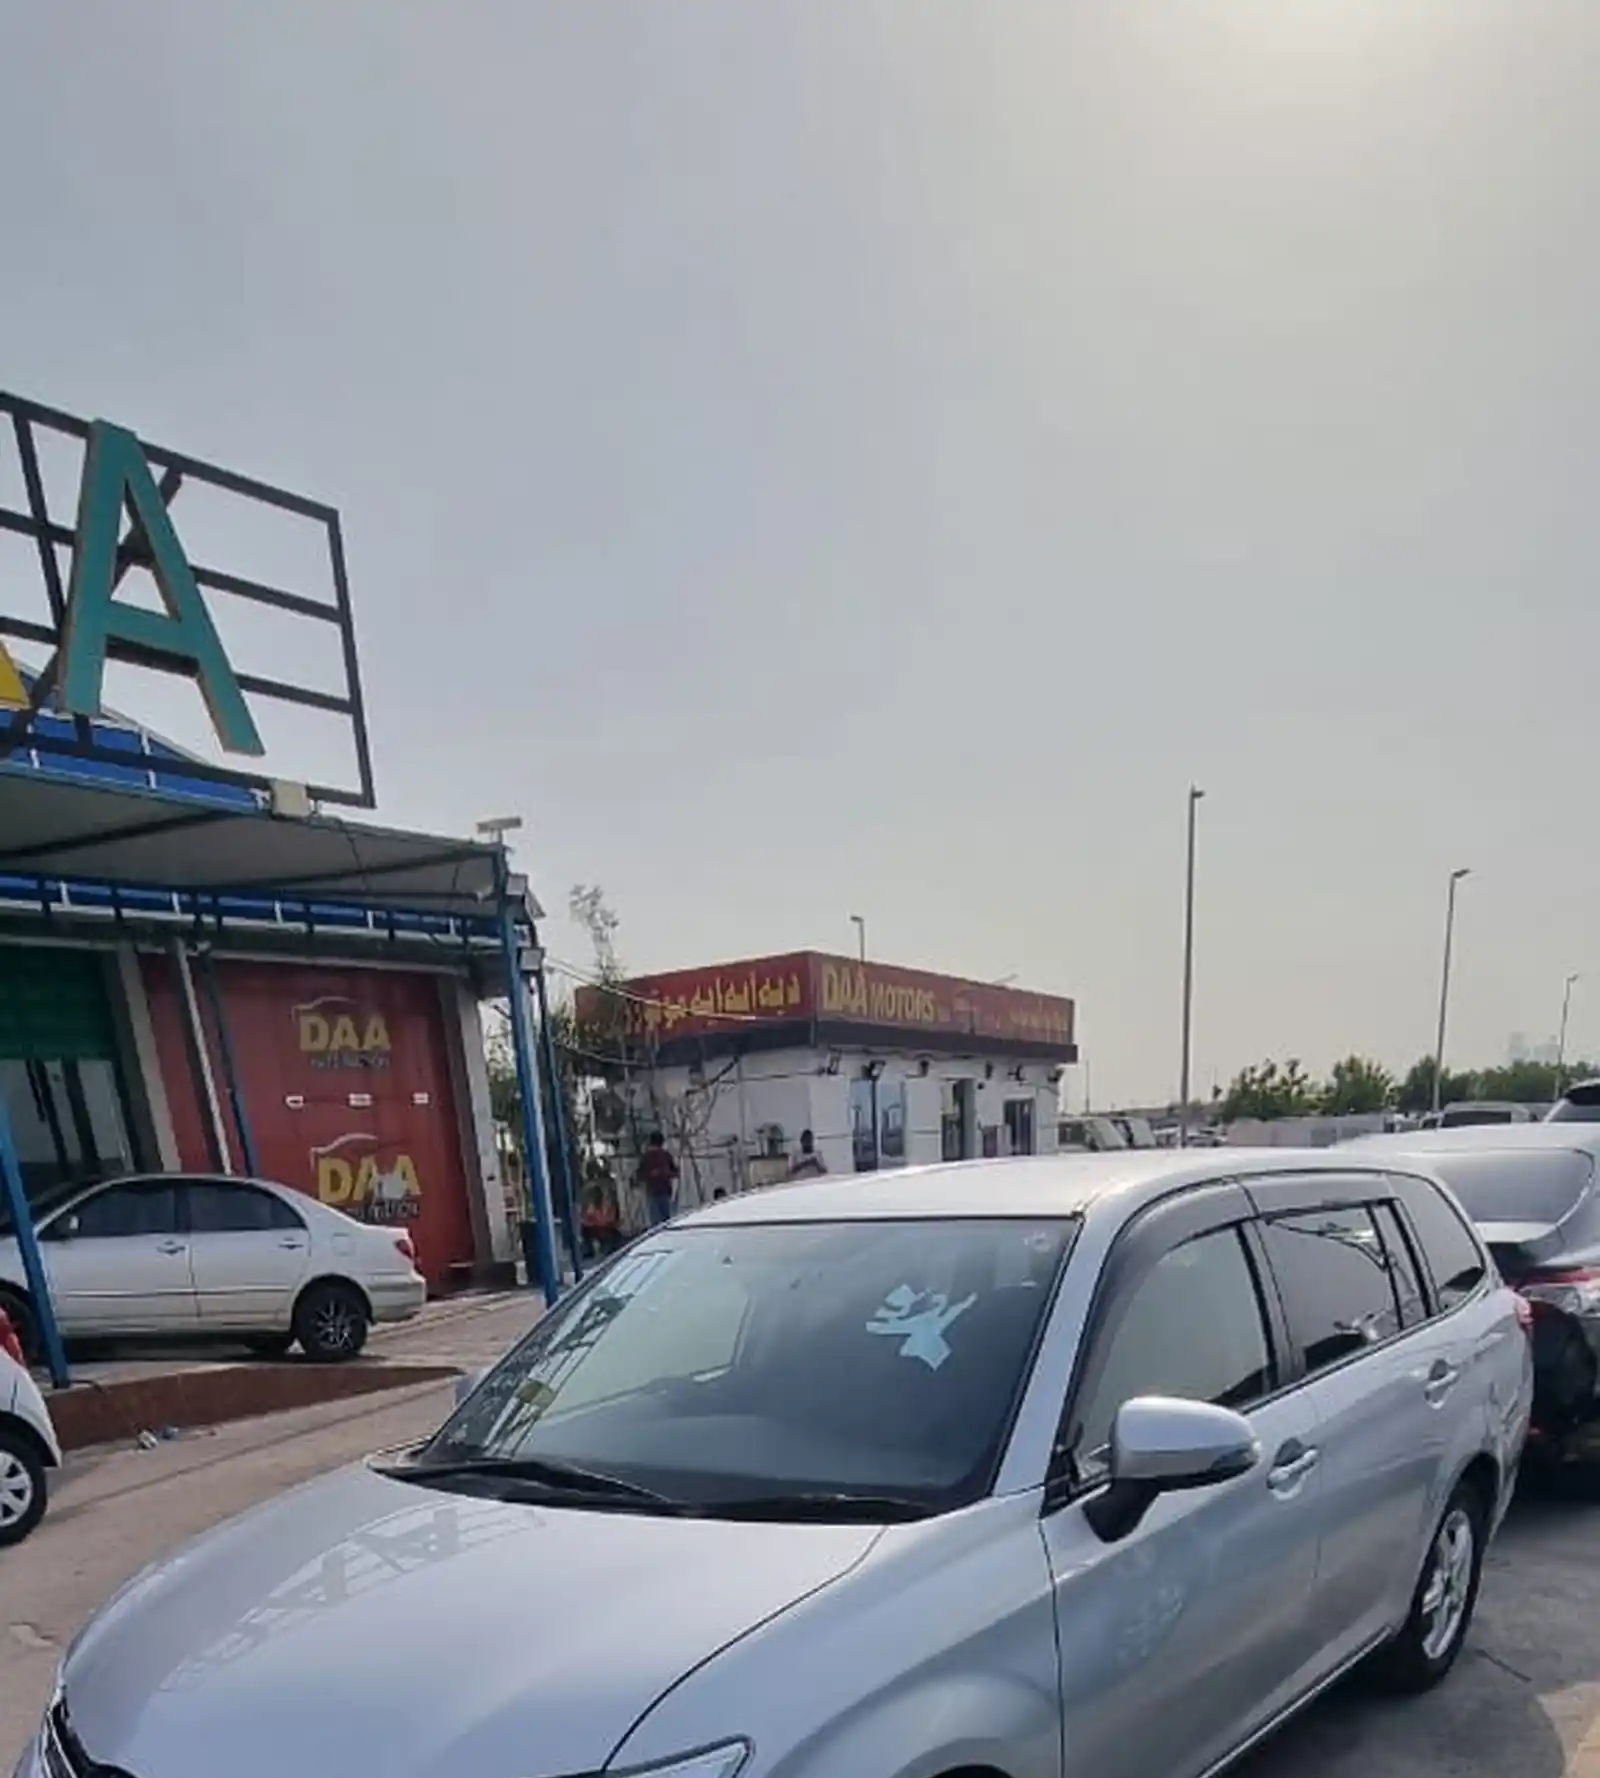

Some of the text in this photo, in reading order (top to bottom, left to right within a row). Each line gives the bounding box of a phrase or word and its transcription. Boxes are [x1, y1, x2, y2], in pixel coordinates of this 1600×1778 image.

[0, 418, 265, 757] A
[821, 962, 869, 1016] DAA
[870, 982, 936, 1021] MOTORS
[299, 1014, 392, 1051] DAA
[318, 1155, 422, 1205] DAA
